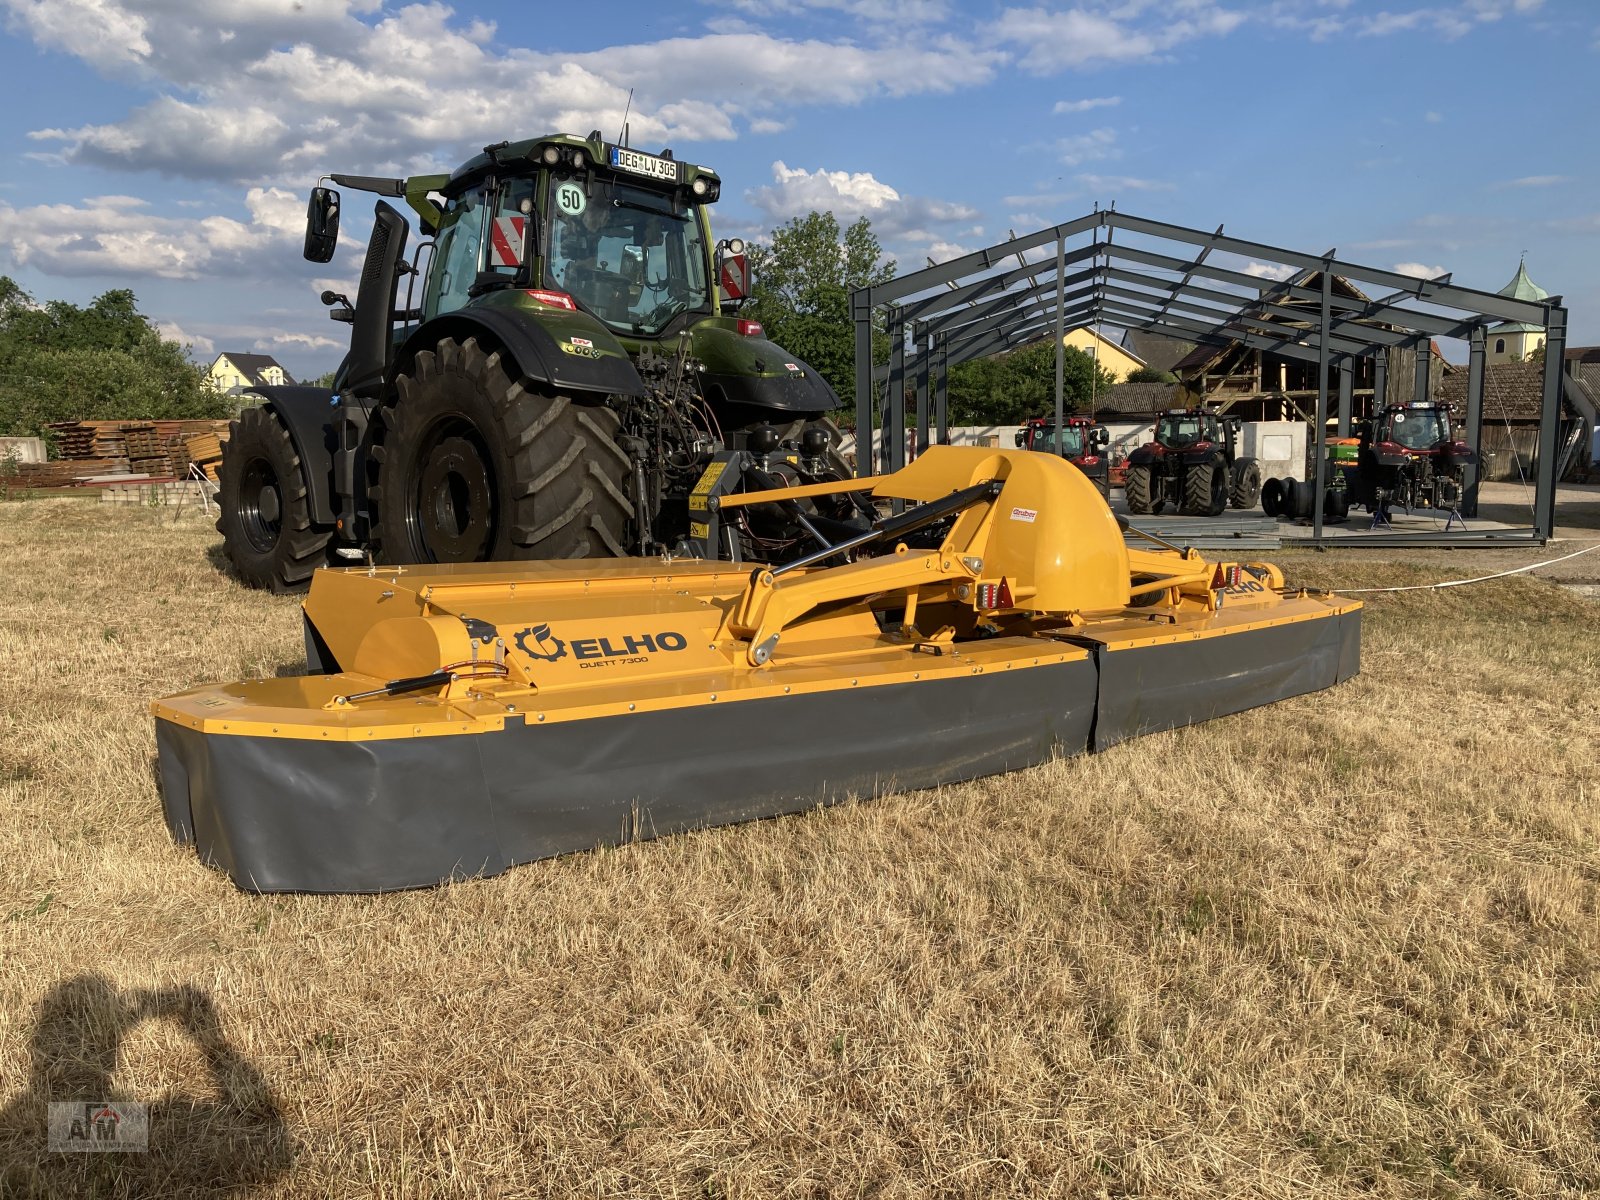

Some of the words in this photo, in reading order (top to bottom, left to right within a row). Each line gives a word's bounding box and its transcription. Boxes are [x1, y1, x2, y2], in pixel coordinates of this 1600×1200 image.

[619, 152, 638, 169] DEG
[644, 155, 657, 173] LV
[658, 161, 675, 177] 305
[562, 189, 581, 210] 50
[570, 631, 688, 660] ELHO
[579, 659, 617, 669] DUETT
[619, 656, 649, 665] 7300
